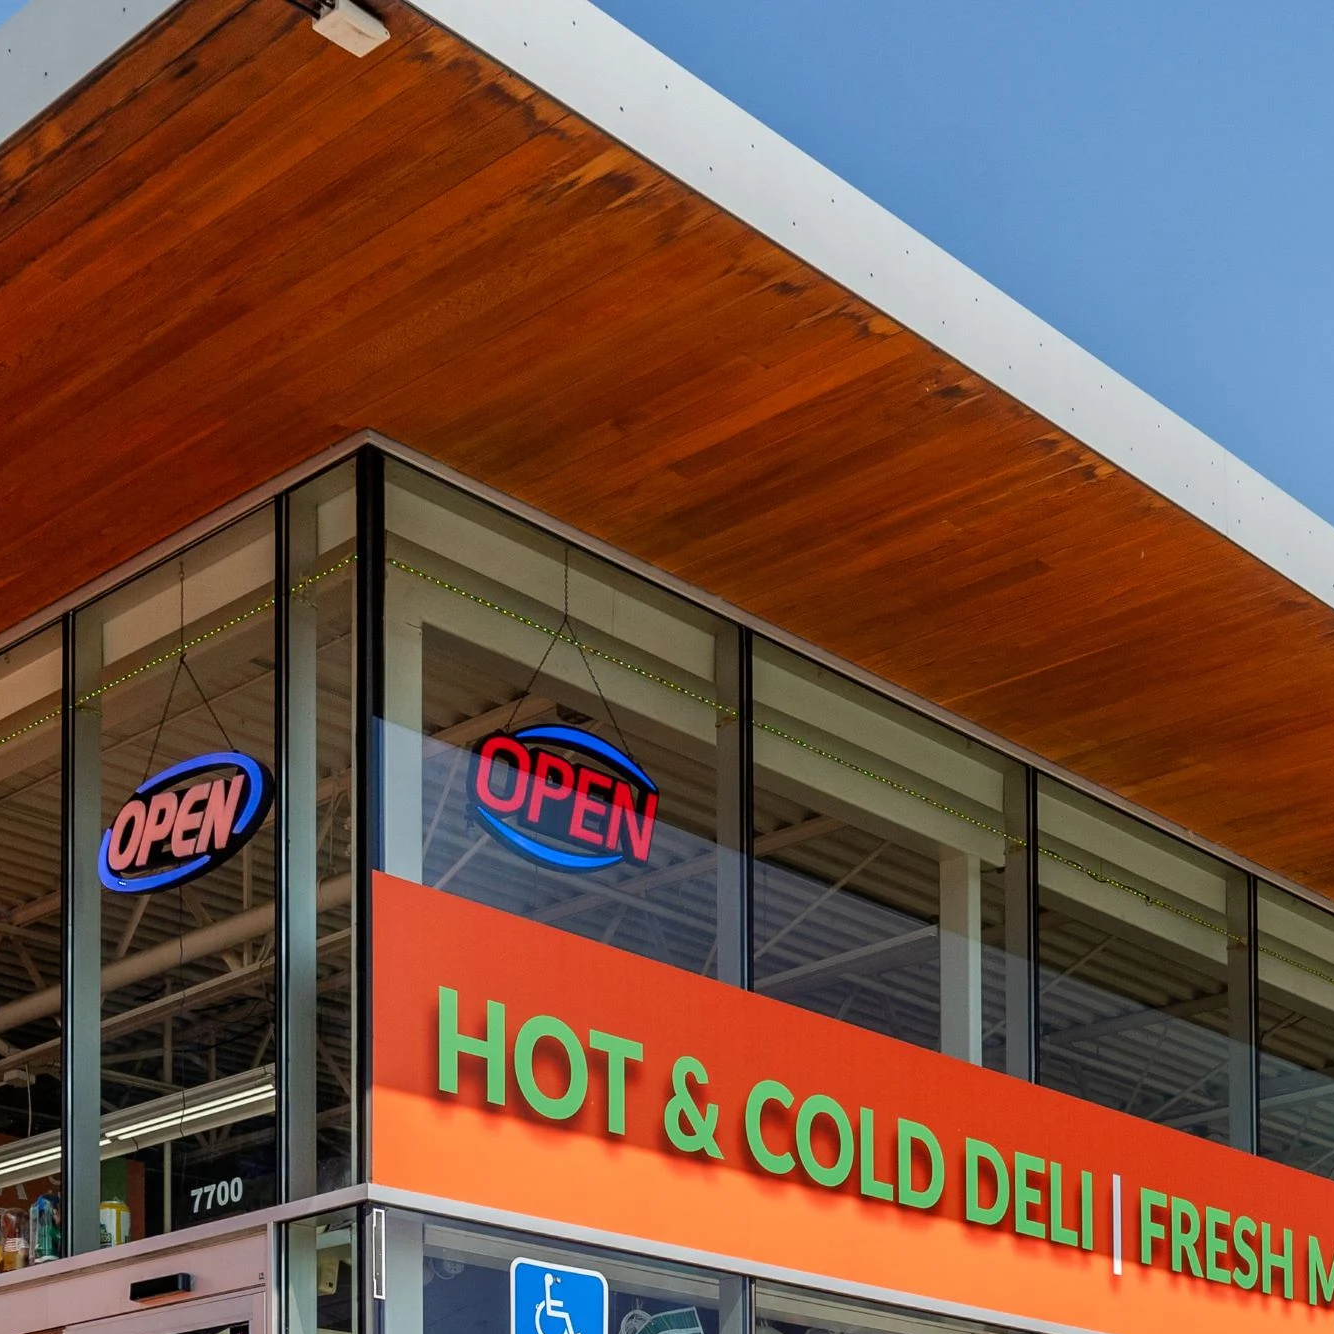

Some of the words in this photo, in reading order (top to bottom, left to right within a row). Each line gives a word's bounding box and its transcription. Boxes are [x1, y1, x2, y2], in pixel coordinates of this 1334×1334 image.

[108, 774, 245, 871] OPEN
[474, 735, 659, 863] OPEN
[190, 1176, 243, 1214] 7700
[437, 985, 644, 1136] HOT
[663, 1055, 724, 1159] &
[744, 1079, 946, 1210] COLD
[965, 1137, 1094, 1250] DELI
[1140, 1187, 1294, 1300] FRESH
